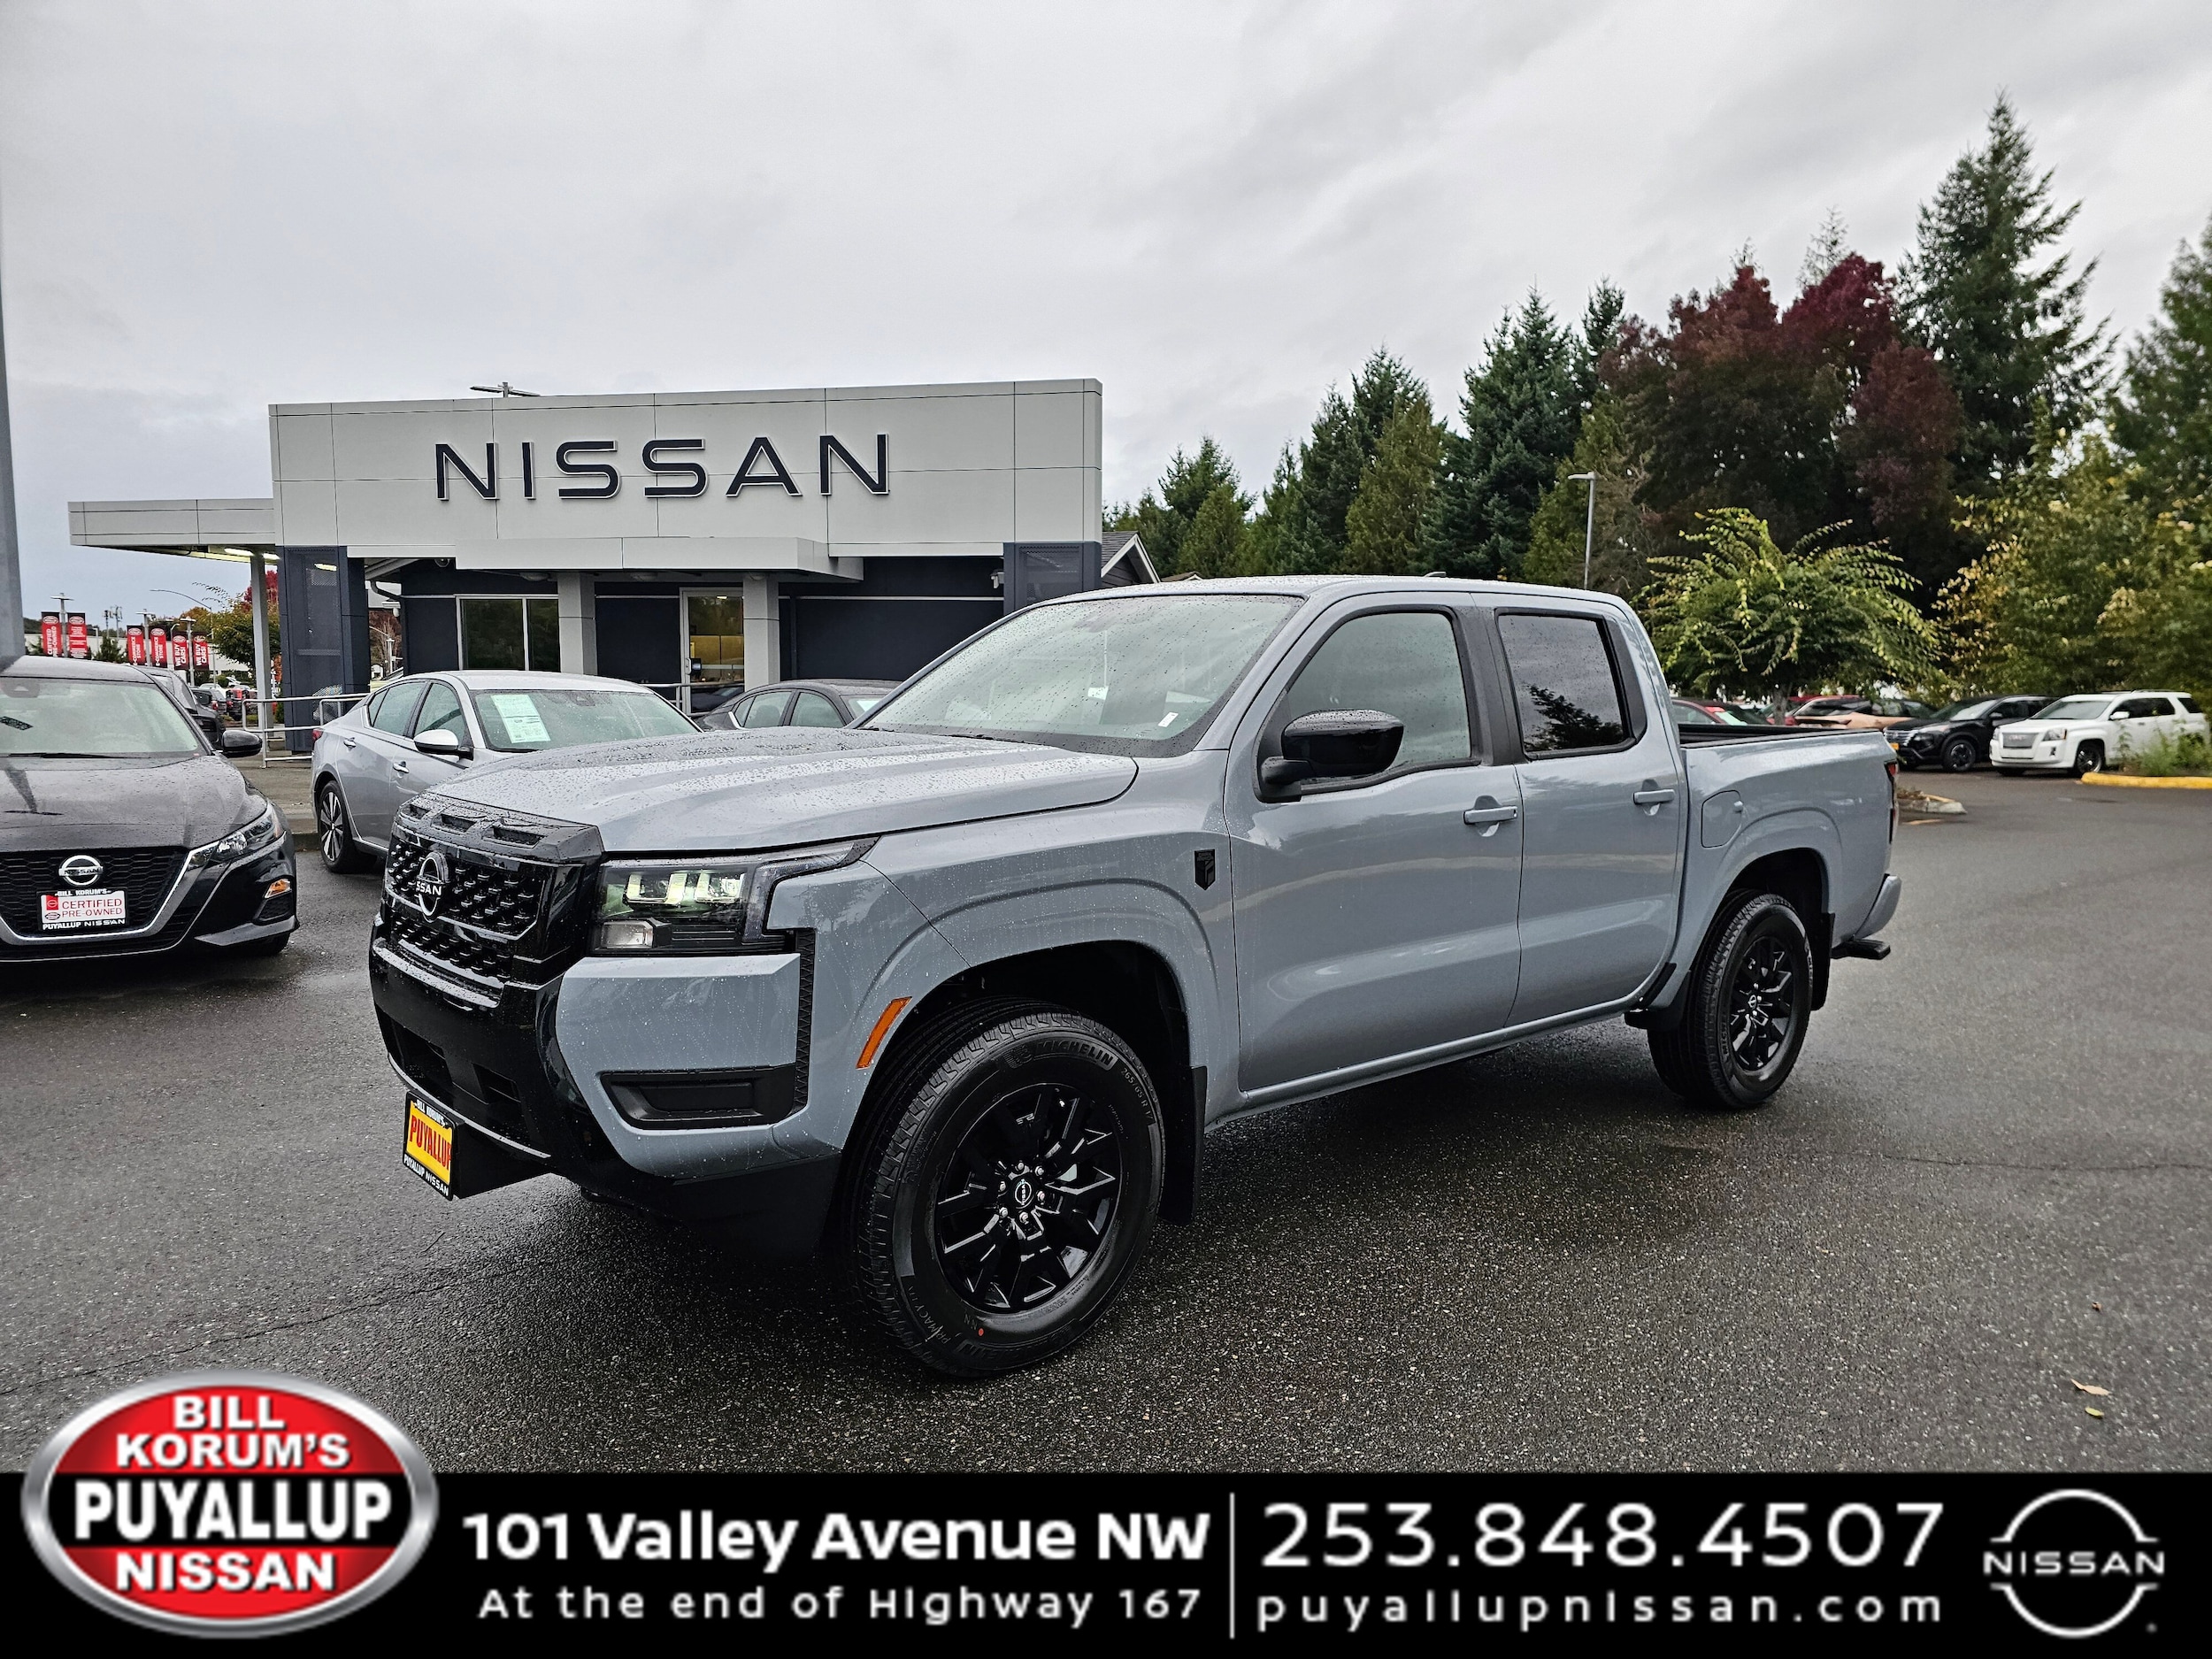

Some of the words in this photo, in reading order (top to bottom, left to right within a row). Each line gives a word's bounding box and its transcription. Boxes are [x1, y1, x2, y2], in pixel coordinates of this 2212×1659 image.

[435, 434, 889, 501] NISSAN
[174, 657, 181, 666] WE
[196, 656, 202, 666] WE
[62, 898, 122, 910] CERTIFIED
[62, 908, 122, 918] PRE-OWNED
[410, 1115, 451, 1170] PUYALLUP
[426, 1171, 449, 1196] NISSAN
